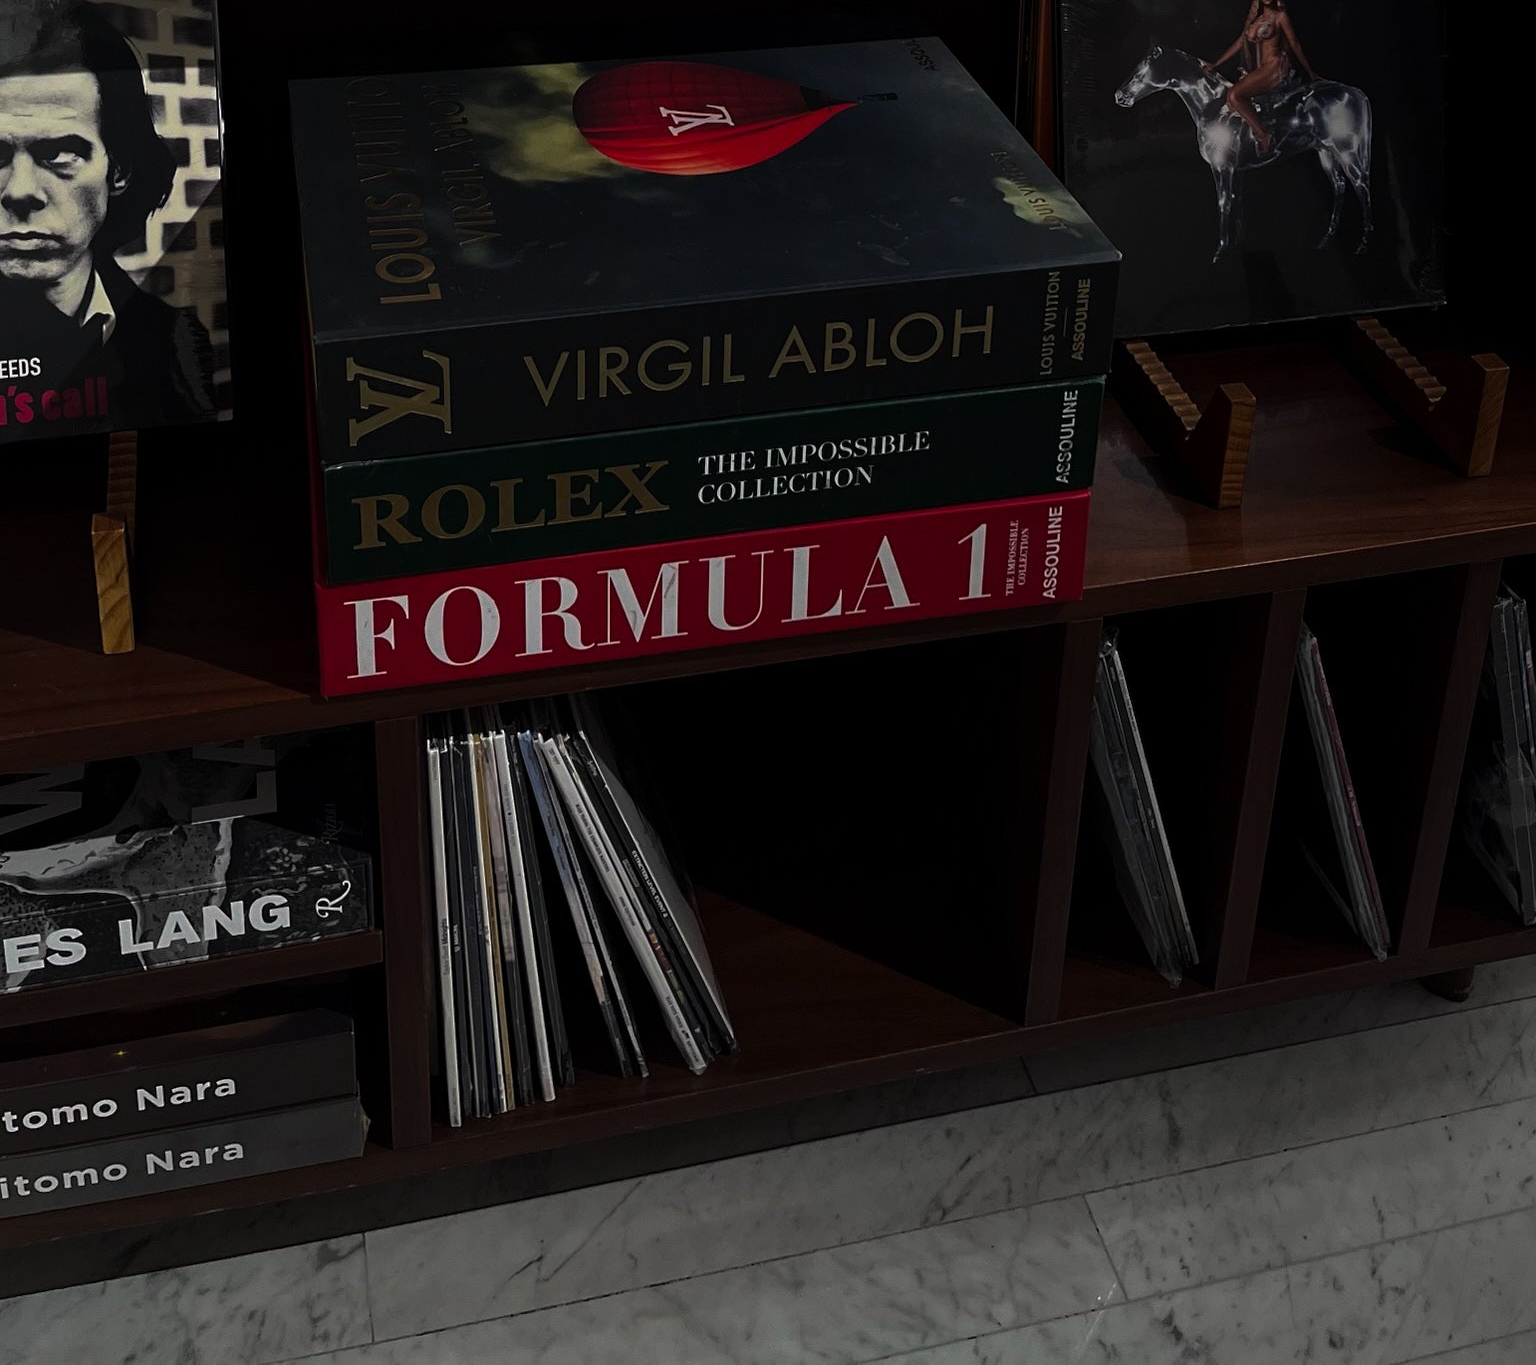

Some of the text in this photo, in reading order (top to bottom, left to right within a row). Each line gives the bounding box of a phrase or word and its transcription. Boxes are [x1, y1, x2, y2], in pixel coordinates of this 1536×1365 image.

[442, 162, 504, 247] VIRGIL
[363, 192, 443, 305] LOUIS
[523, 304, 995, 407] VIRGIL ABLOH
[1039, 270, 1062, 376] LOUIS VUITTON
[1071, 277, 1092, 363] ASSOULINE
[41, 376, 109, 420] call
[1054, 389, 1079, 485] ASSOULINE
[697, 431, 931, 477] THE IMPOSSIBLE
[697, 464, 876, 506] COLLECTION
[351, 460, 671, 551] ROLEX
[1005, 520, 1019, 597] THE IMPOSSIBLE
[1016, 526, 1030, 586] COLLECTION
[1042, 505, 1064, 599] ASSOULINE
[343, 522, 992, 679] FORMULA 1
[315, 880, 352, 919] R
[646, 878, 657, 895] LEVEL
[3, 893, 292, 974] ES LANG
[2, 1076, 237, 1133] tomo Nara
[0, 1142, 244, 1200] itomo Nara
